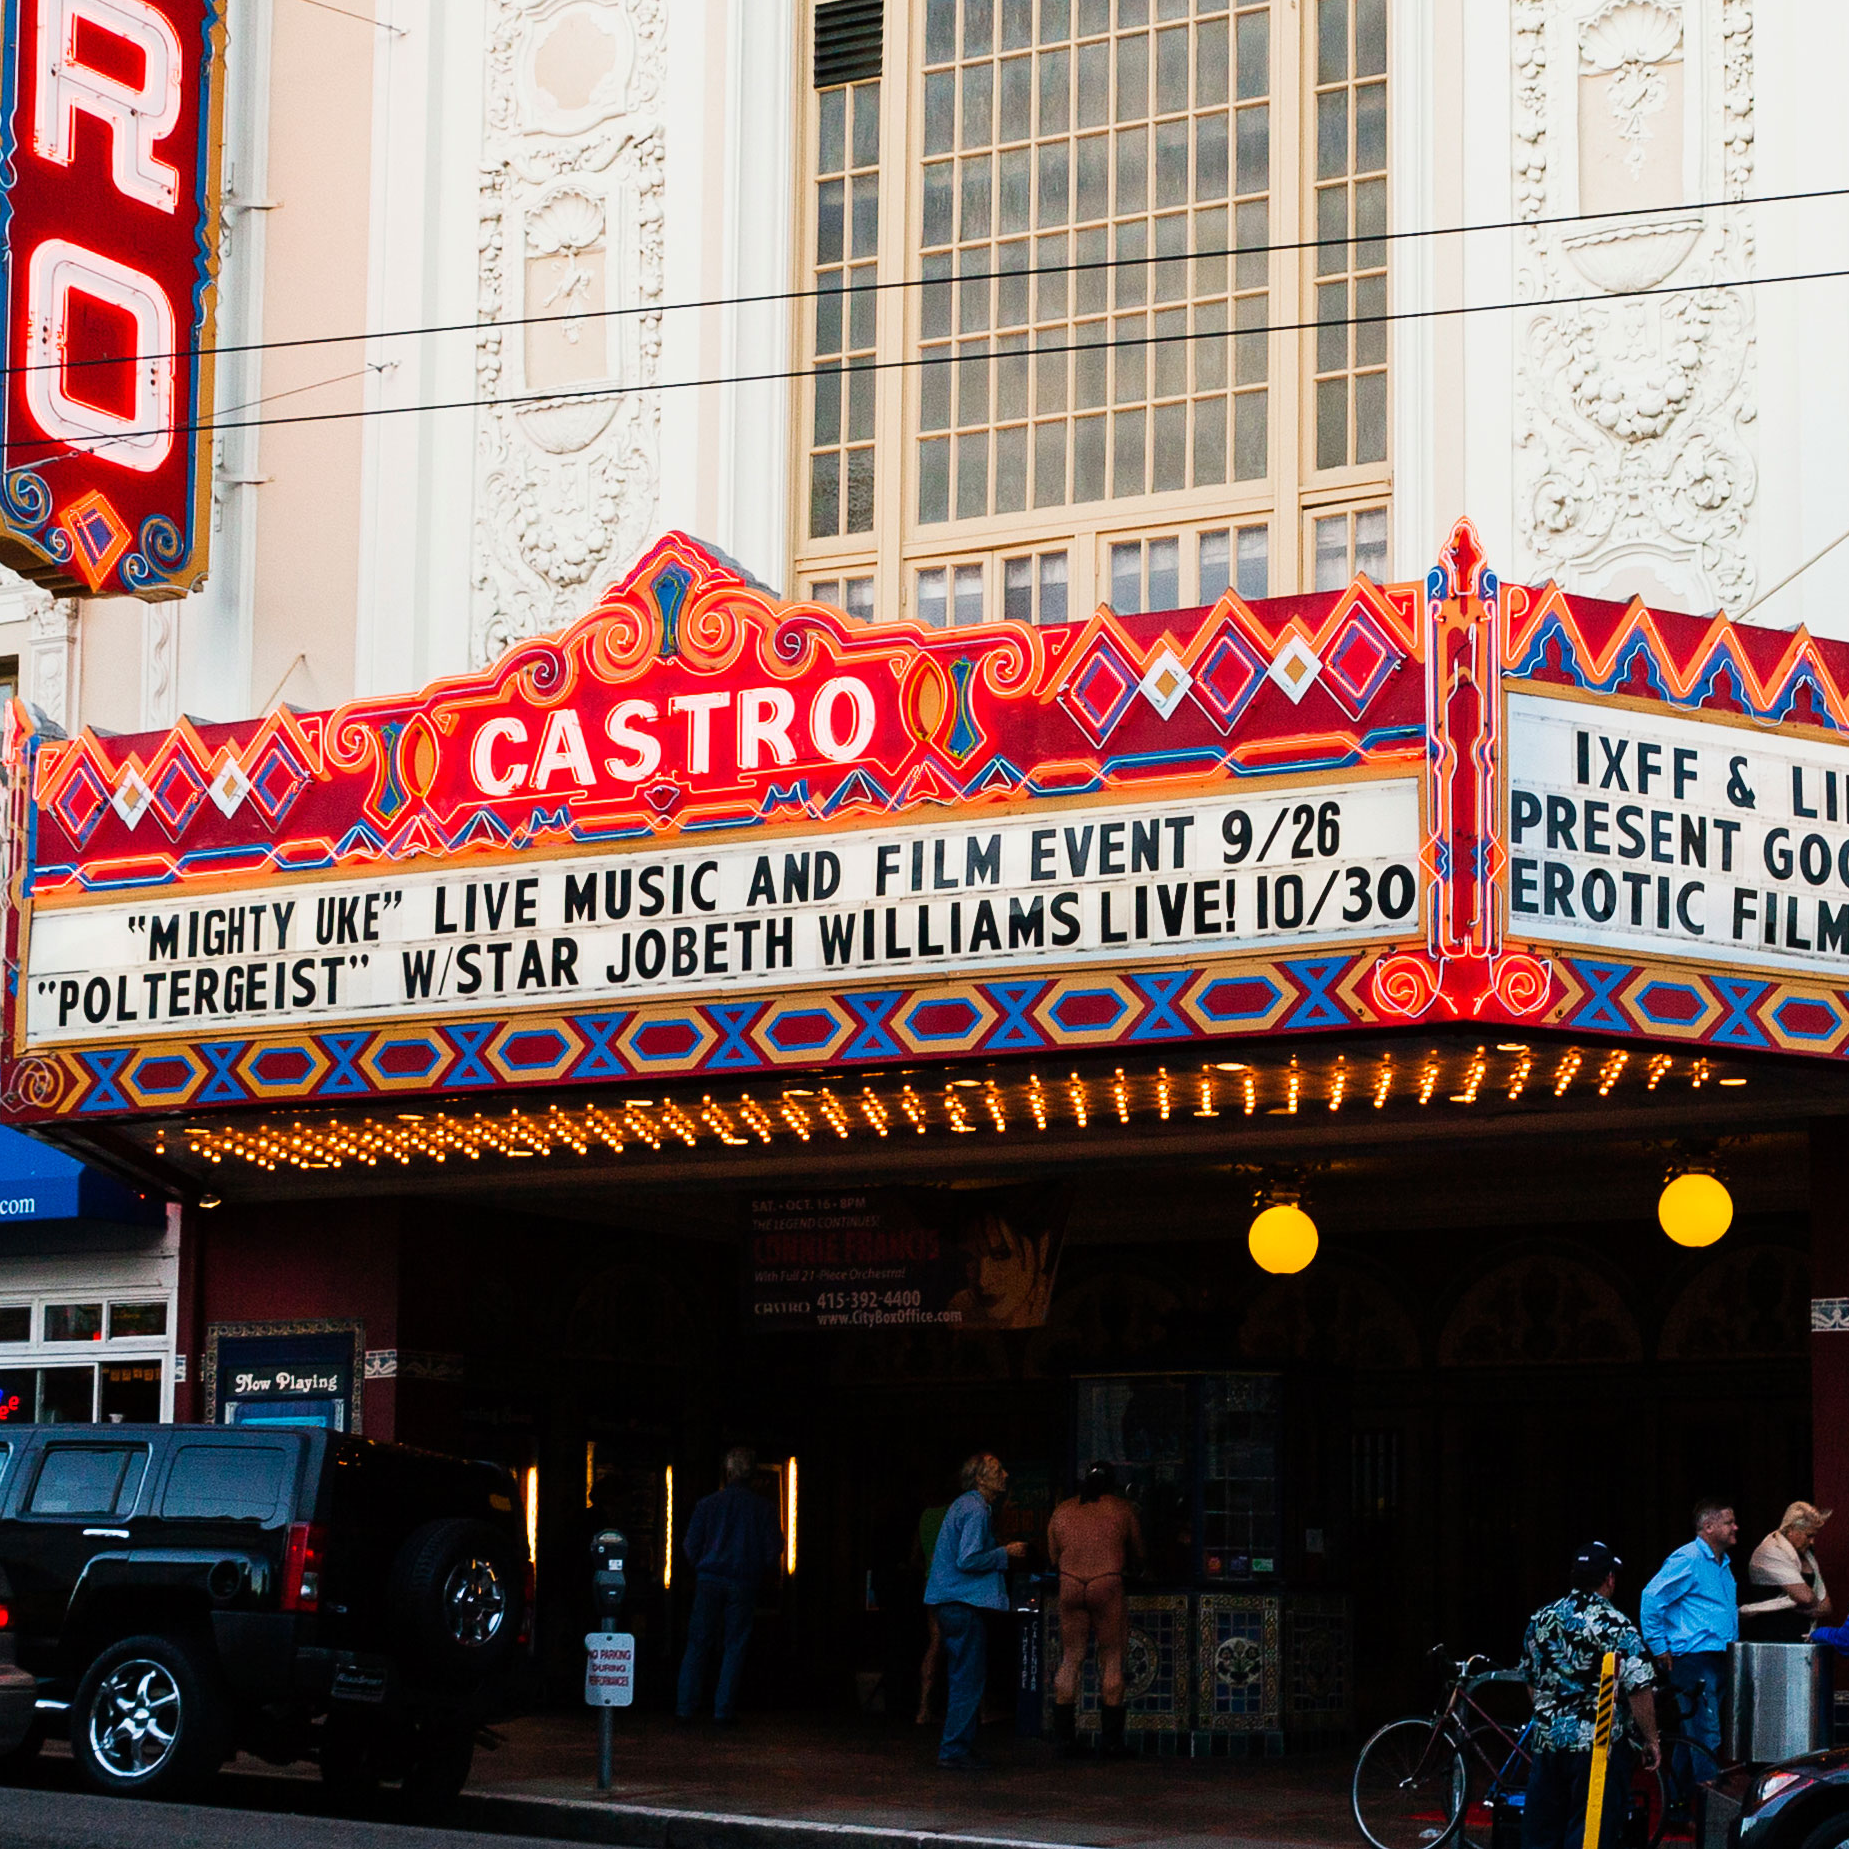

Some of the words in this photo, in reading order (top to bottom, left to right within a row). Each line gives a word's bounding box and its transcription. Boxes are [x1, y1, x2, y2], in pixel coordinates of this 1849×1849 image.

[471, 675, 876, 797] CASTRO
[1576, 730, 1698, 800] IXFF
[1726, 755, 1756, 810] &
[1510, 788, 1741, 873] PRESENT
[127, 900, 296, 962] "MIGHTY
[315, 889, 403, 944] UKE"
[435, 877, 538, 935] LIVE
[564, 860, 718, 926] MUSIC
[749, 849, 842, 907] AND
[875, 831, 1001, 897] FILM
[1030, 814, 1195, 883] EVENT
[1221, 800, 1341, 867] 9/26
[1510, 858, 1706, 936] EROTIC
[36, 954, 370, 1028] "POLTERGEIST"
[401, 934, 579, 1001] W/STAR
[606, 915, 793, 983] JOBETH
[819, 891, 1081, 967] WILLIAMS
[1099, 878, 1237, 946] LIVE!
[1256, 863, 1417, 931] 10/30
[752, 1217, 774, 1231] THE
[773, 1216, 816, 1230] LEGEND
[817, 1289, 922, 1310] 415-392-4400
[817, 1308, 963, 1329] www.CityBoxOffice.com
[235, 1373, 271, 1393] Now
[276, 1372, 338, 1393] Playing
[591, 1664, 626, 1673] DURING
[600, 1650, 632, 1660] PARKING
